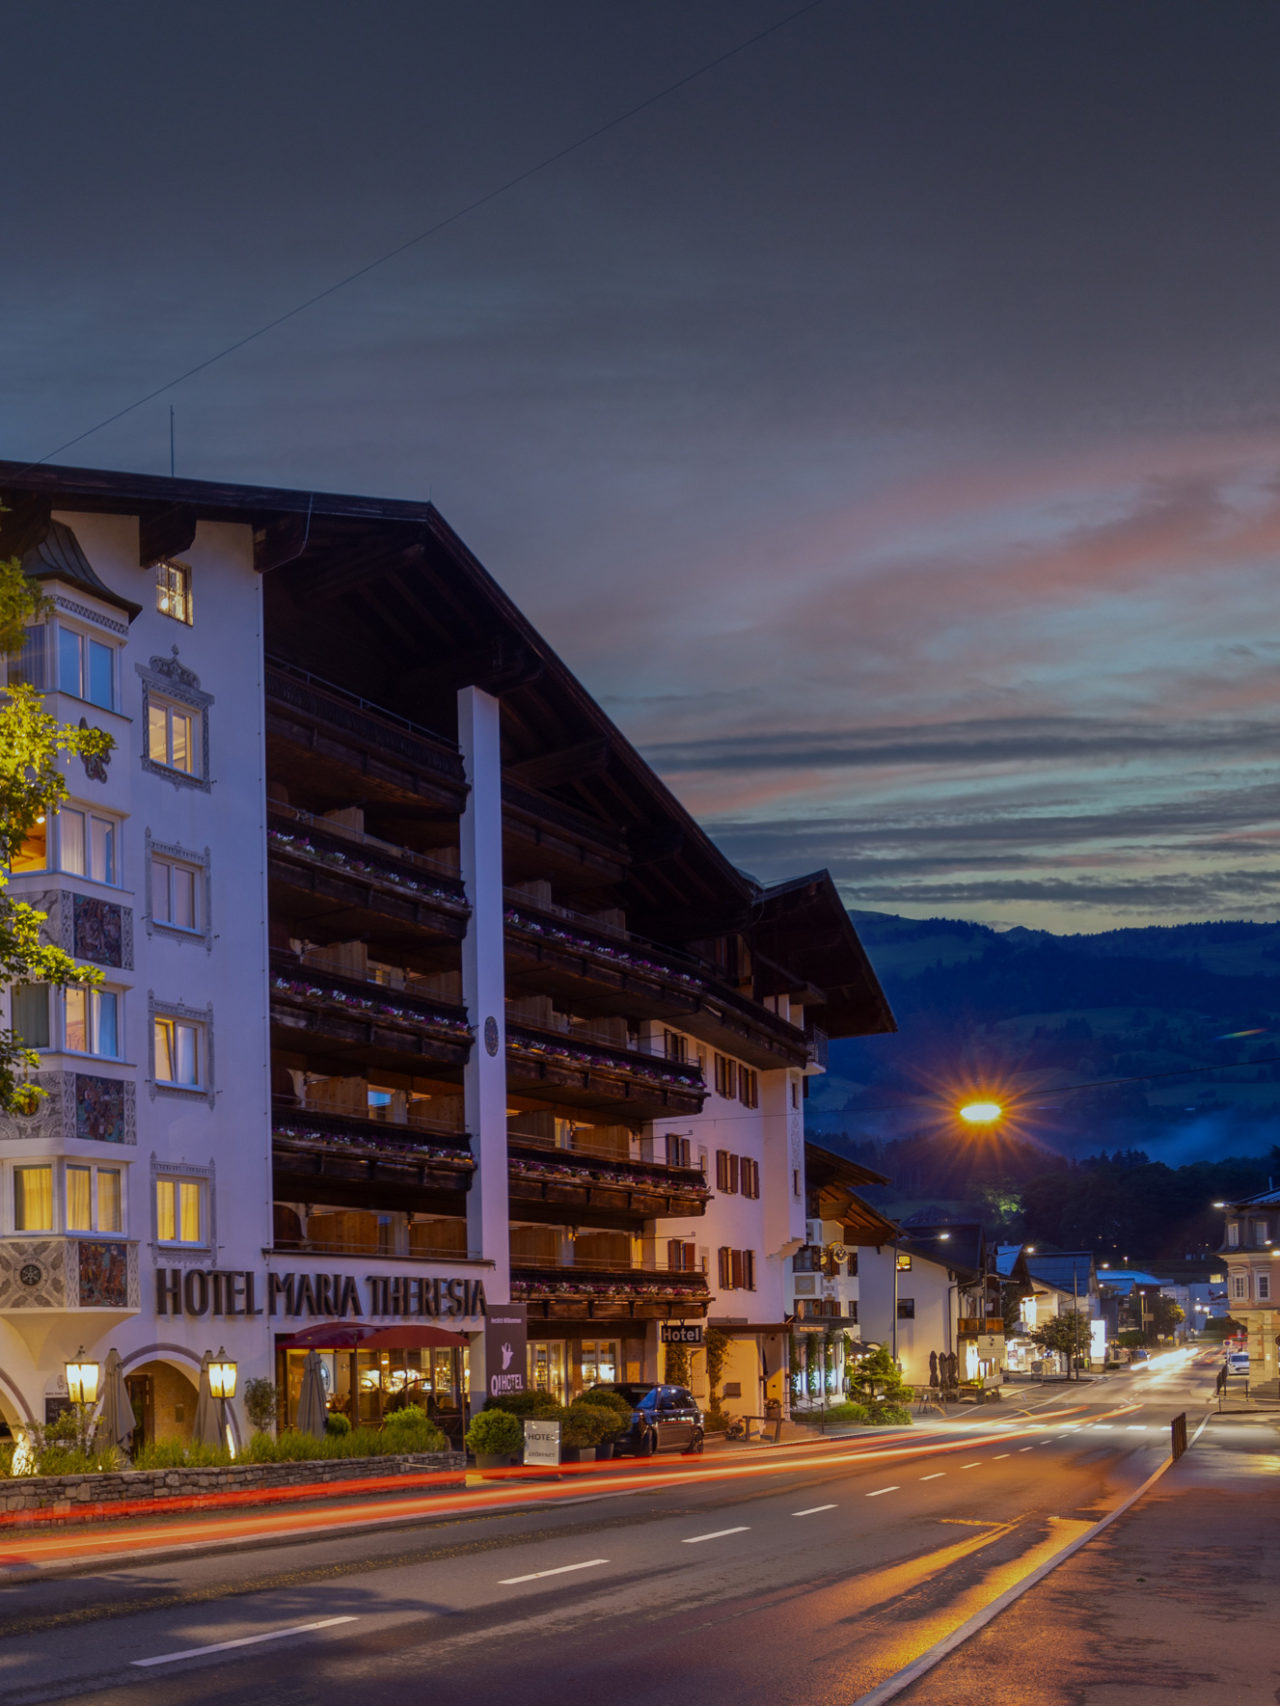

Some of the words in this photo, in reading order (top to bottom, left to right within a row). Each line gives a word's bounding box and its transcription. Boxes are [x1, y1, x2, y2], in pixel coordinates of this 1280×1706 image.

[156, 1268, 263, 1316] HOTEL
[268, 1272, 363, 1317] MARIA
[365, 1275, 488, 1317] THERESIA
[663, 1327, 699, 1341] Hotel
